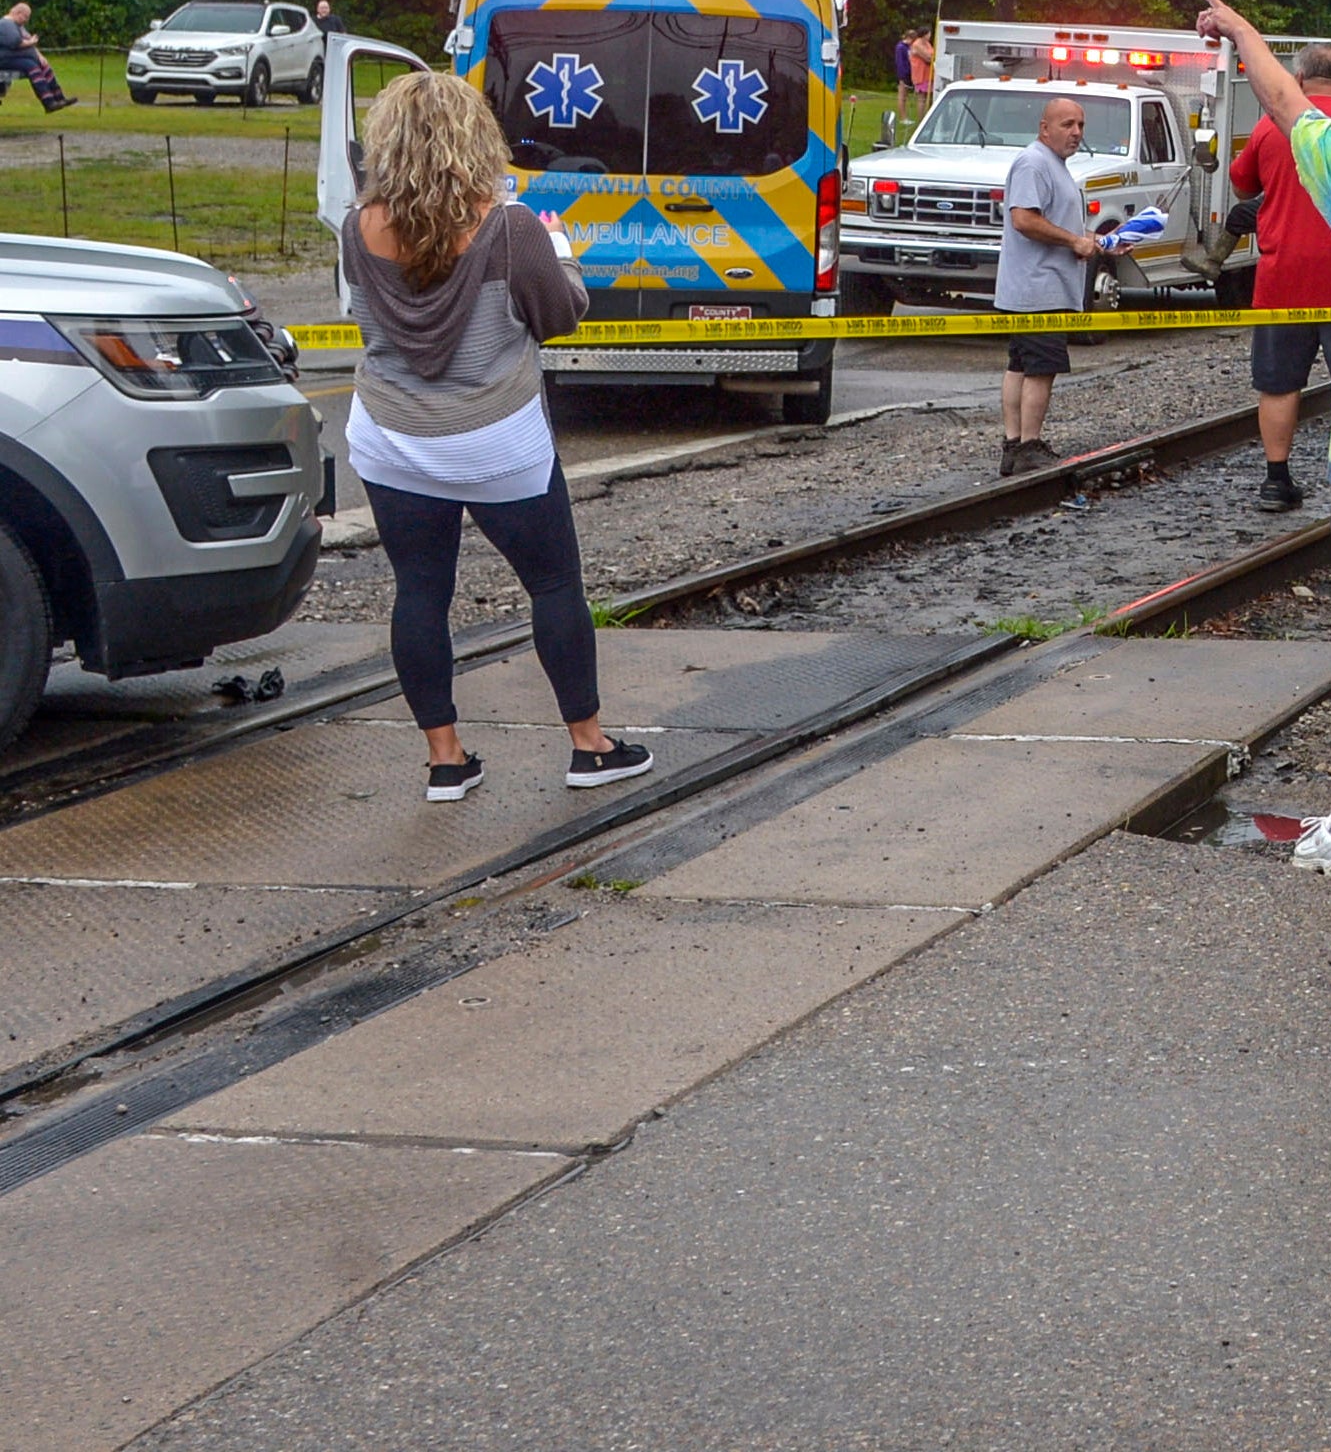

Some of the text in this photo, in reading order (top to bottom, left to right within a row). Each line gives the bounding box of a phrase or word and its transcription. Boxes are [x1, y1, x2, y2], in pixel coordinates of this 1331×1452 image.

[527, 175, 759, 200] KANAWHA COUNTY
[565, 222, 730, 246] AMBULANCE
